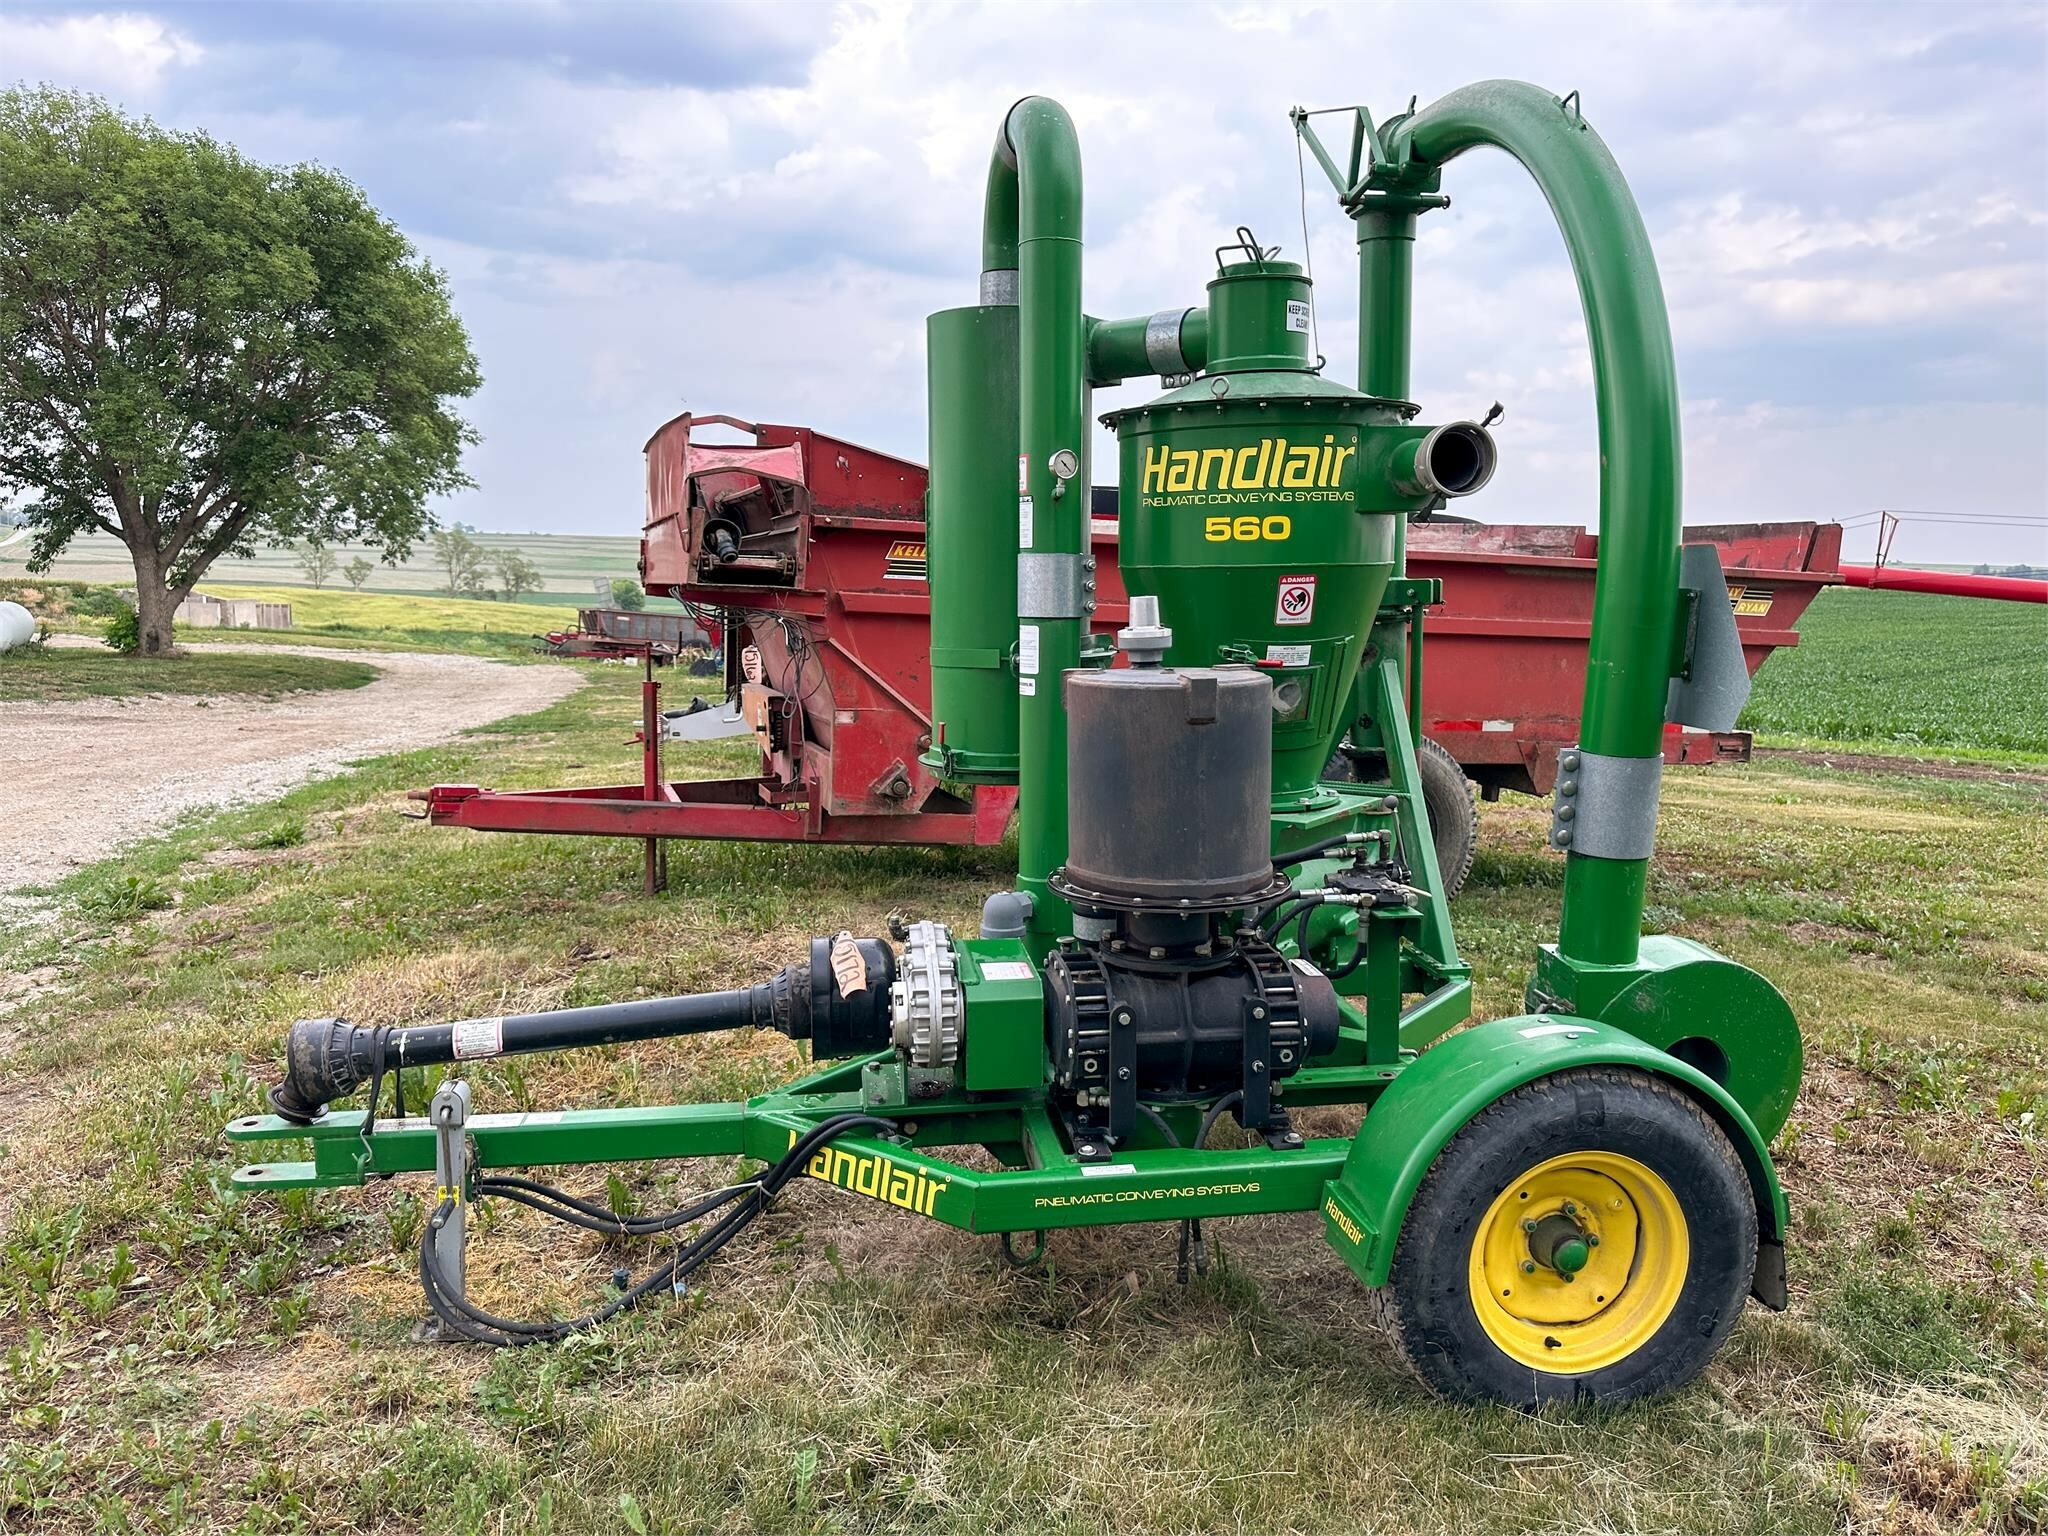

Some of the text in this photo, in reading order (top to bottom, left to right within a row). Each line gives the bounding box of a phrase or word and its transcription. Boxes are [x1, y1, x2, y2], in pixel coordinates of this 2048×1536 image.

[1288, 304, 1301, 315] KEEP
[1142, 434, 1356, 494] Handlair
[1142, 491, 1355, 507] PNEUMATIC CONVEYING SYSTEMS
[1204, 515, 1291, 542] 560
[1737, 602, 1769, 613] RYAN
[1034, 1182, 1261, 1208] PNEUMATIC CONVEYING SYSTEMS
[1325, 1196, 1365, 1246] Handlair
